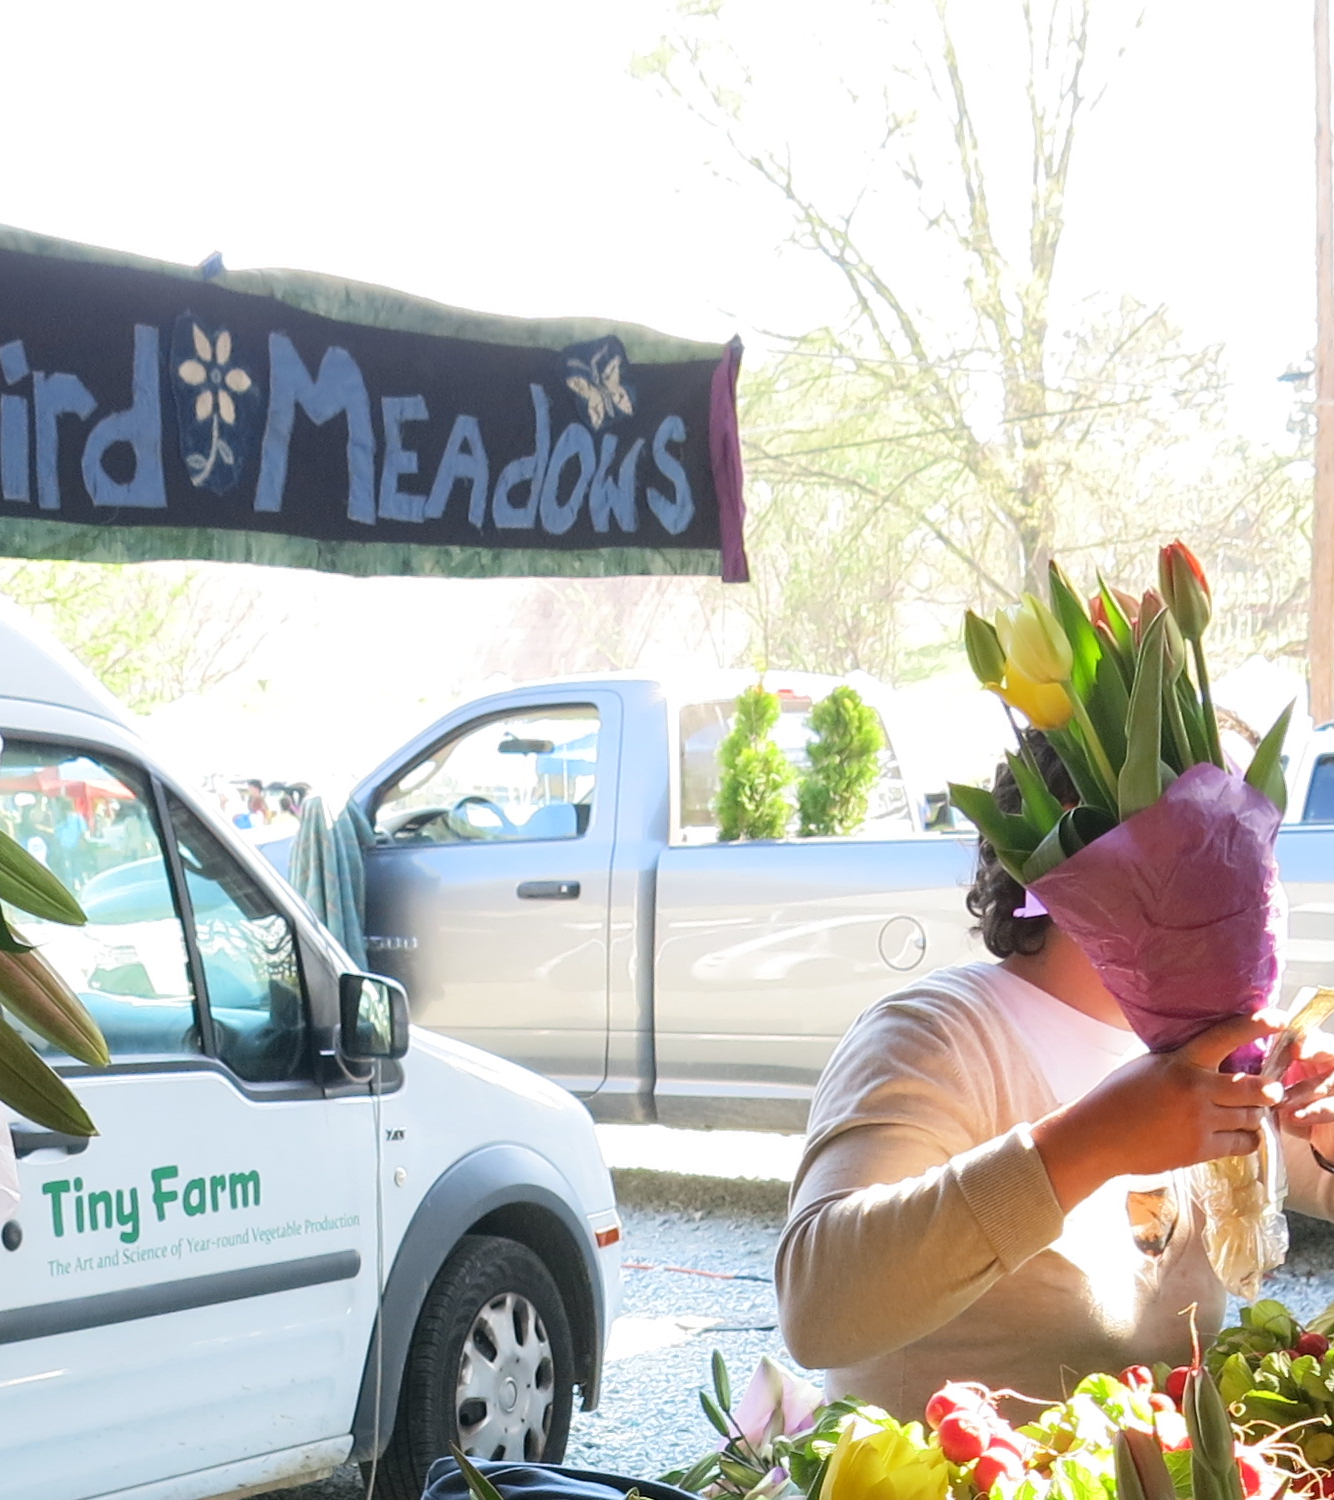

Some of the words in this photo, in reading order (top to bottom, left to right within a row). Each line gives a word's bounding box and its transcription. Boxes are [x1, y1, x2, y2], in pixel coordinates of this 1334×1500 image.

[42, 1176, 140, 1244] Tiny
[151, 1164, 261, 1222] Farm
[47, 1259, 72, 1277] The
[74, 1256, 94, 1273] Art
[96, 1252, 119, 1268] and
[122, 1246, 168, 1265] Science
[170, 1238, 185, 1260] of
[186, 1228, 250, 1254] Year-round
[251, 1219, 302, 1245] Vegetable
[304, 1212, 361, 1235] Production
